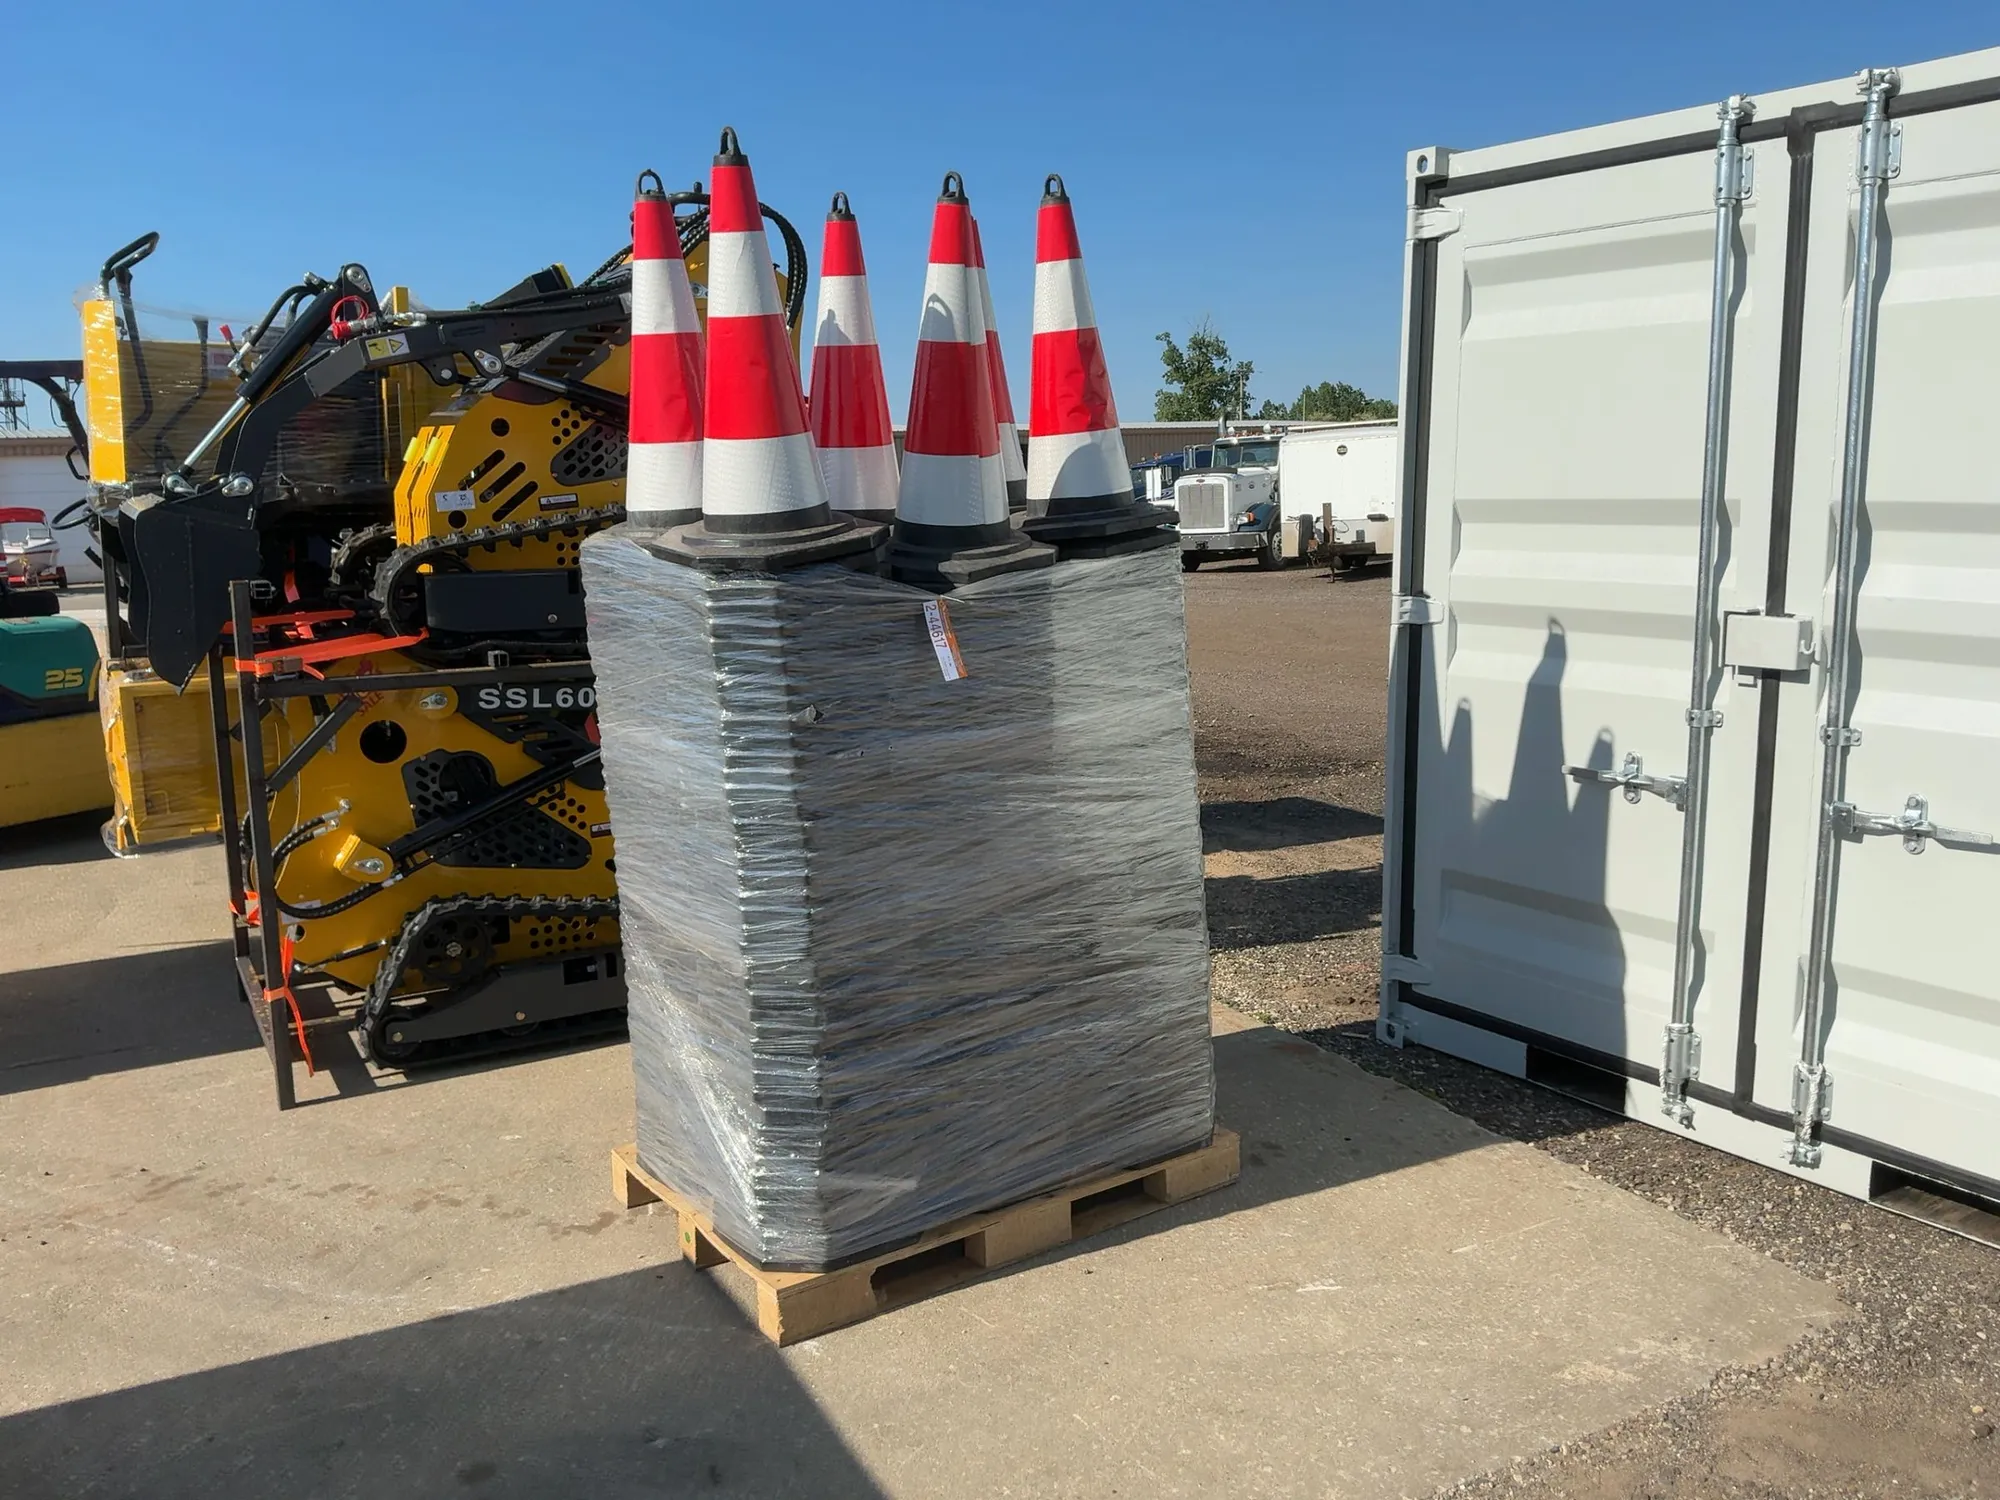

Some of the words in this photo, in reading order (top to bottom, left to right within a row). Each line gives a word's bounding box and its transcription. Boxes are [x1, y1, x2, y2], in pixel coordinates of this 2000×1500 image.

[925, 604, 947, 649] 2-44617
[45, 667, 84, 691] 25
[478, 687, 595, 710] SSL60
